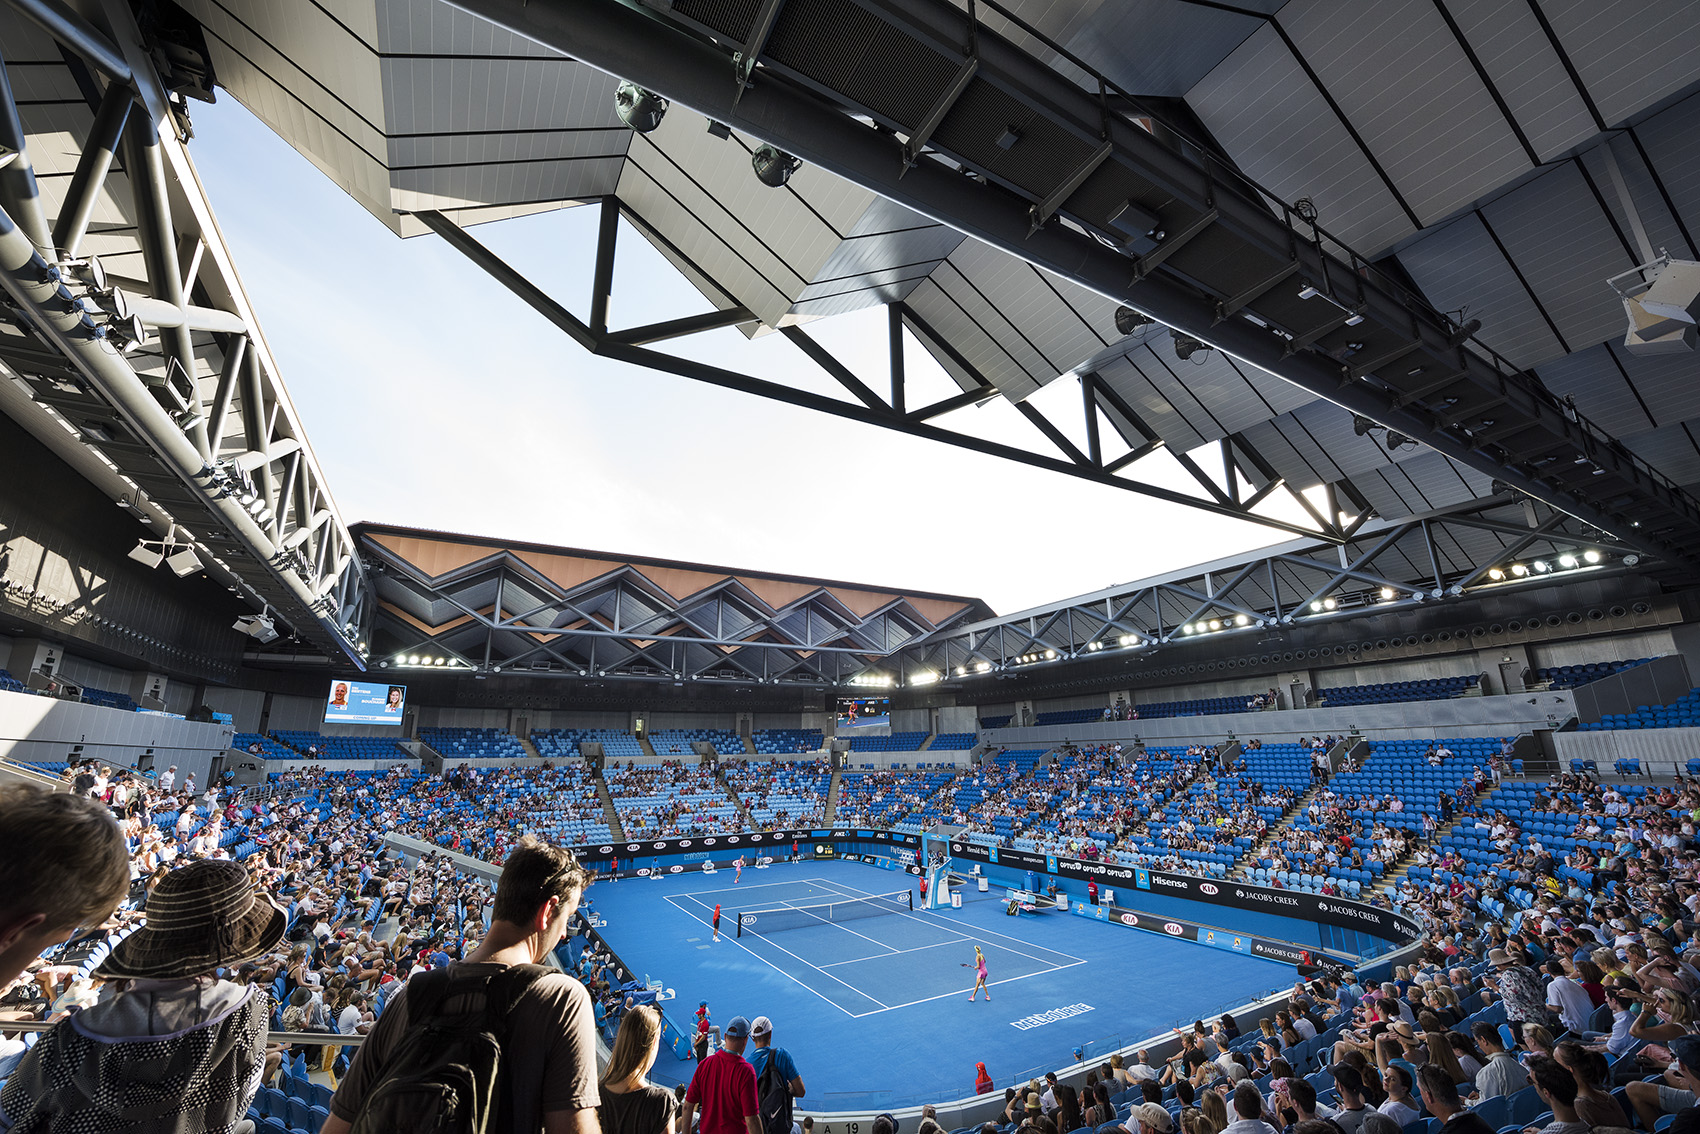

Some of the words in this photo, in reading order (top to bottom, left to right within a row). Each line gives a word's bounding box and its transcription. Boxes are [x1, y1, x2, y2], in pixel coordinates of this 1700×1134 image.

[1152, 876, 1188, 888] Hisense
[1202, 885, 1216, 893] KIA
[1245, 892, 1273, 902] JACOB'S
[1274, 896, 1299, 906] CREEK
[1123, 915, 1136, 924] KIA
[1329, 904, 1358, 917] JACOB'S
[1358, 910, 1380, 924] CREEK
[1166, 924, 1181, 933] KIA
[1263, 947, 1286, 957] JACOB'S
[1287, 951, 1304, 960] CREE
[824, 1125, 831, 1134] A
[846, 1122, 859, 1134] 19
